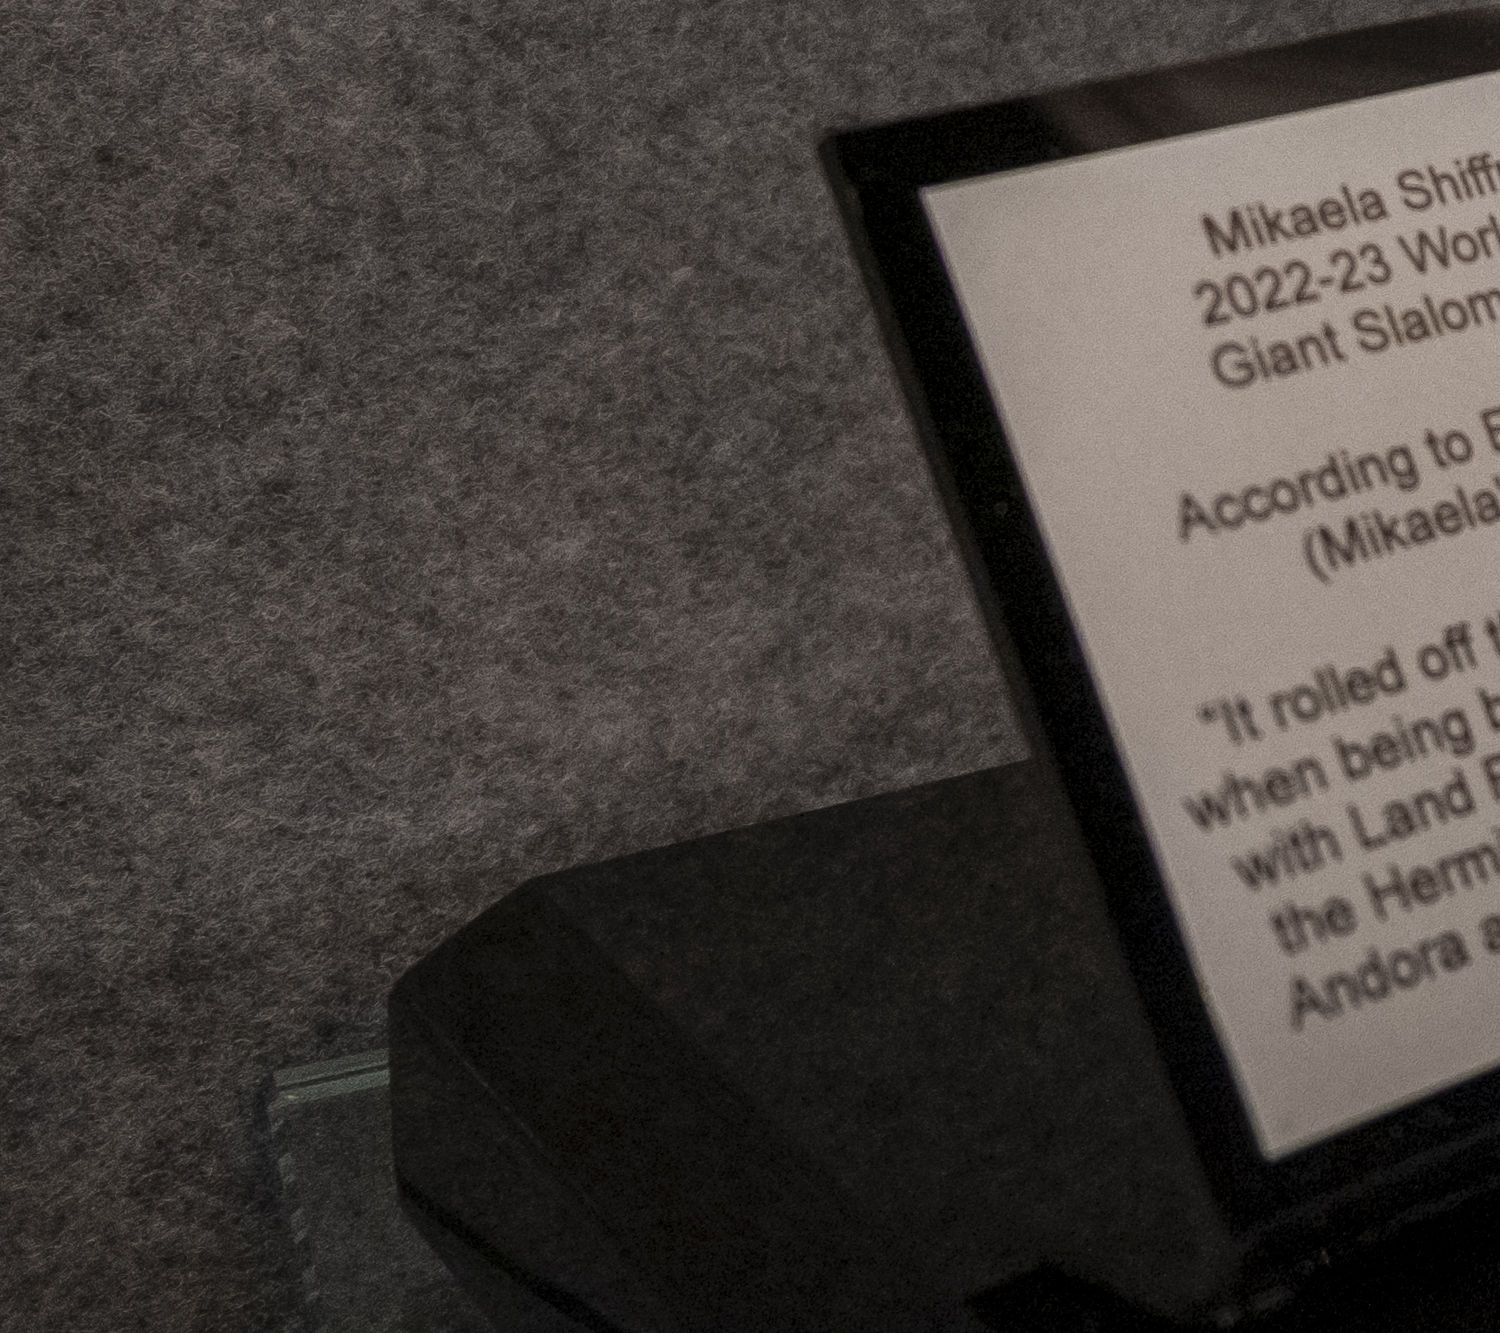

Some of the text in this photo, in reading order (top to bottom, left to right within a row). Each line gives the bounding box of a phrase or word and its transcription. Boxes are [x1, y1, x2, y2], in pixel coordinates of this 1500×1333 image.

[1198, 182, 1390, 258] Mikaela
[1191, 240, 1394, 329] 2022-23
[1208, 320, 1348, 391] Giant
[1176, 442, 1422, 543] According
[1421, 428, 1475, 471] to
[1266, 645, 1409, 730] rolled
[1415, 619, 1478, 683] off
[1182, 755, 1330, 832] when
[1331, 706, 1477, 783] being
[1230, 819, 1344, 892] with
[1345, 767, 1478, 853] Land
[1267, 894, 1358, 957] the
[1288, 928, 1473, 1031] Andora
